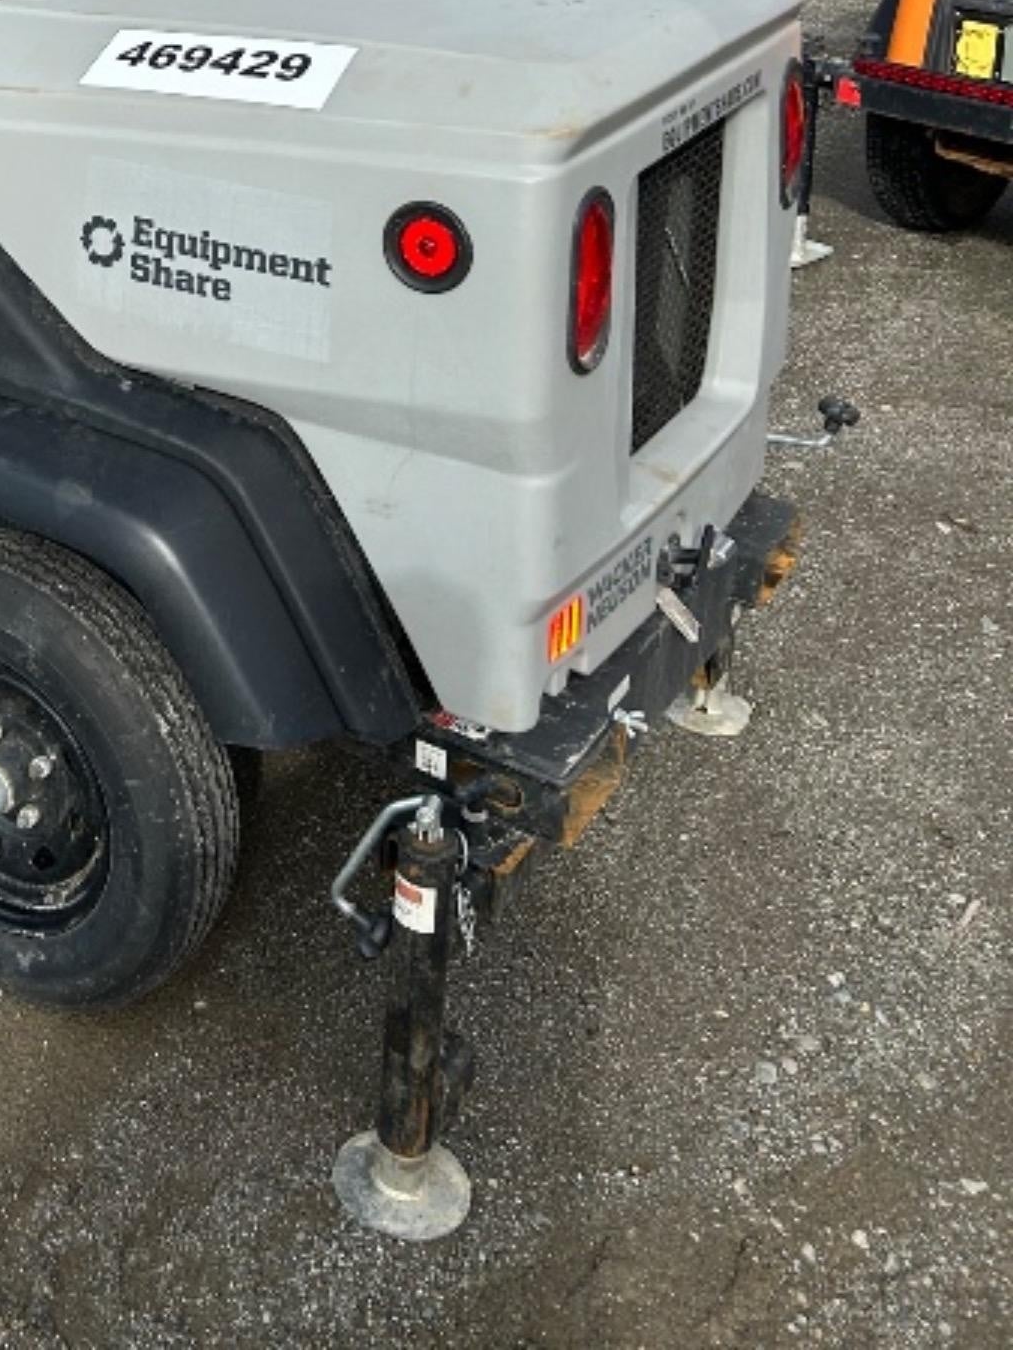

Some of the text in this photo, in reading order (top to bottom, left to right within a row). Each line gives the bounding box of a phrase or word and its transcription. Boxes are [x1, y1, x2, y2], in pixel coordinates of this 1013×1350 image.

[116, 40, 313, 83] 469429
[131, 215, 333, 288] Equipment
[130, 252, 231, 301] Share
